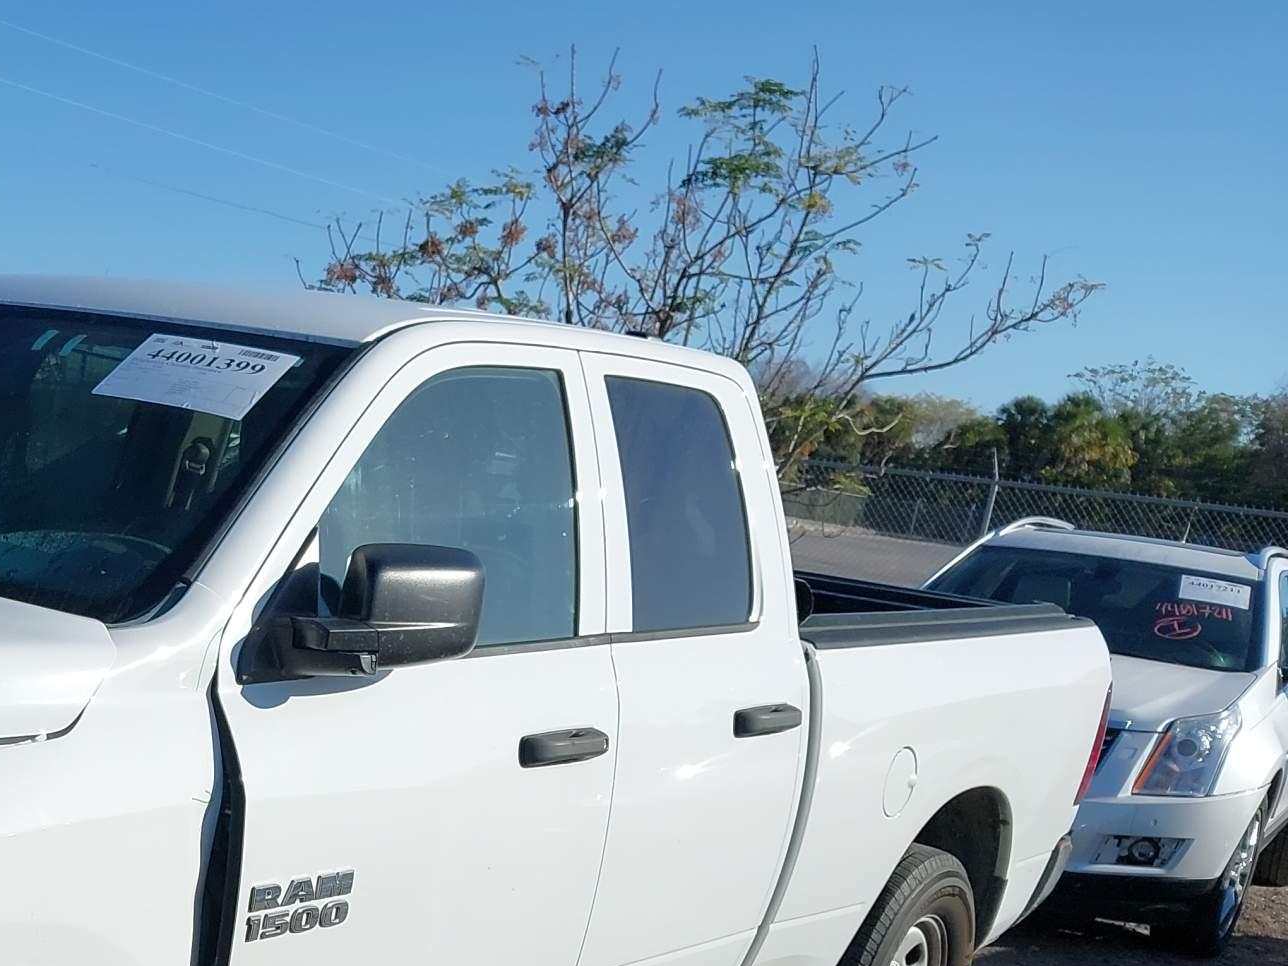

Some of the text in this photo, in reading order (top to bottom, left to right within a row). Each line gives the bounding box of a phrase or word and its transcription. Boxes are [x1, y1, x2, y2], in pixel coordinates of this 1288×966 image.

[146, 348, 266, 375] 44001399
[248, 869, 355, 913] RAM
[245, 899, 350, 943] 1500
